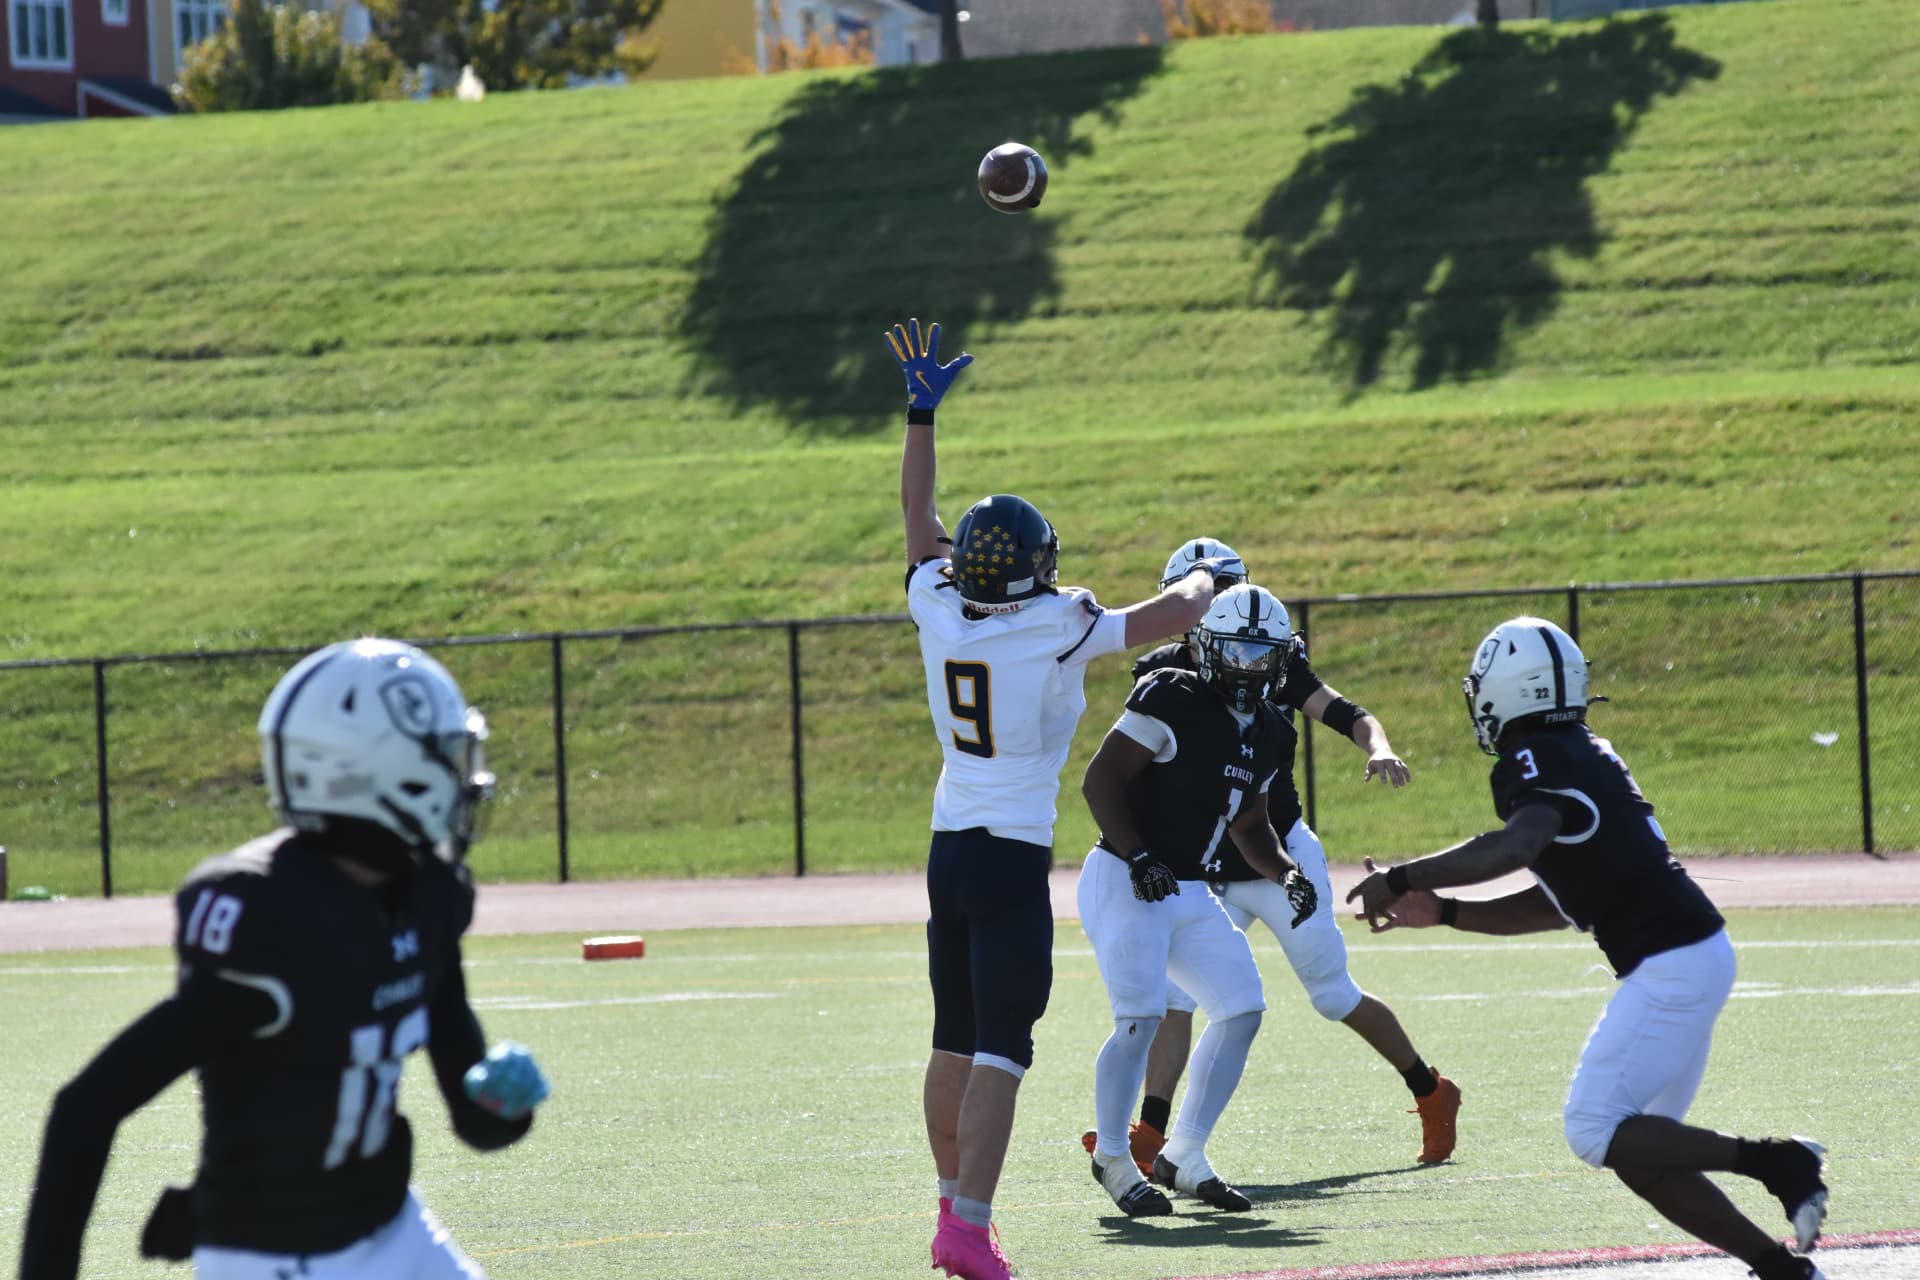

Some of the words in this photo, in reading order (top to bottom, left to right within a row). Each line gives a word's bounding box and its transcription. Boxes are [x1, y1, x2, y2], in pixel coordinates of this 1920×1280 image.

[944, 658, 997, 759] 9
[1535, 687, 1549, 699] 22
[1545, 711, 1577, 723] FRIARS
[1224, 764, 1254, 785] CURLEY
[1516, 748, 1538, 779] 3
[1200, 787, 1243, 865] 1
[185, 888, 242, 954] 18
